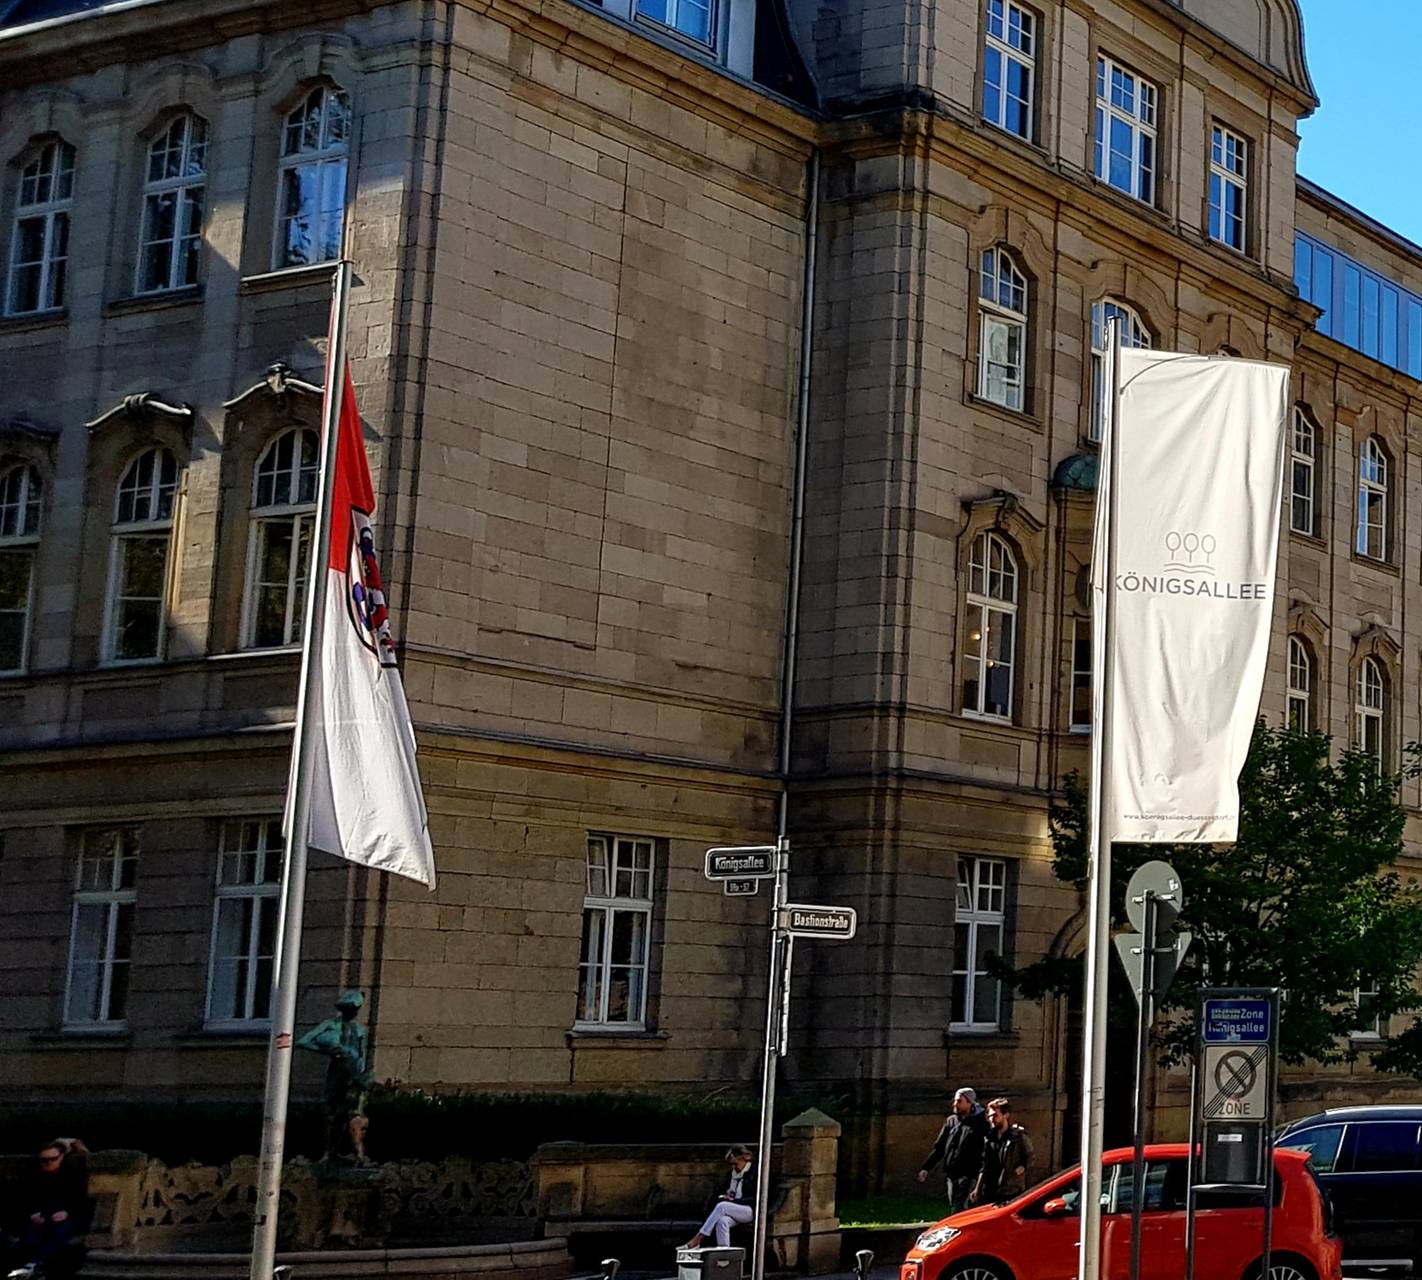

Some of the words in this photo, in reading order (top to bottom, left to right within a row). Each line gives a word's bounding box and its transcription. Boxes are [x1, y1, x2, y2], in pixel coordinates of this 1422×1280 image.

[715, 856, 765, 872] Königsallee
[793, 913, 849, 929] Bastionstraße
[1240, 1008, 1264, 1019] Zone
[1218, 1102, 1251, 1115] ZONE
